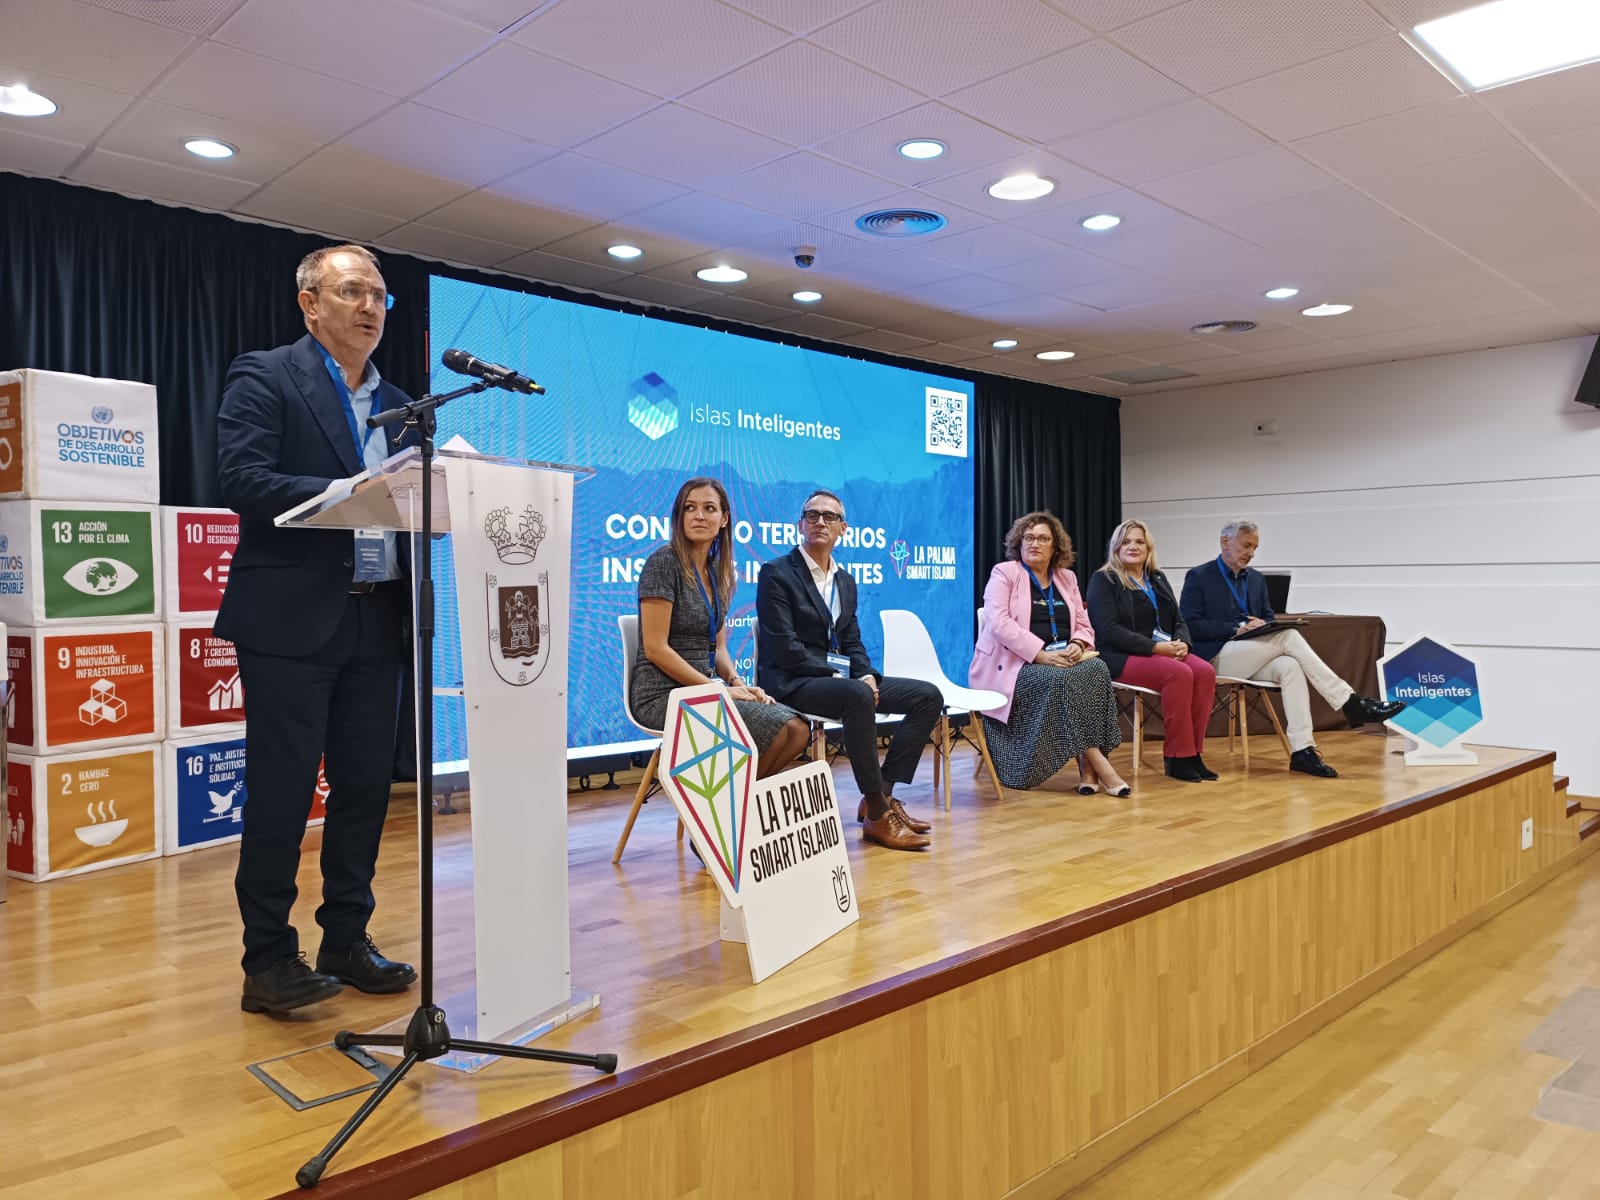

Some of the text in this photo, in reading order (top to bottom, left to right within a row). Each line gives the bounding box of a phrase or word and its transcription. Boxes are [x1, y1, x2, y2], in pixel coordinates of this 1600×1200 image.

[690, 401, 842, 441] Islas Inteligentes
[57, 423, 145, 445] OBJETIVOS
[58, 438, 145, 455] DE DESARROLLO
[58, 449, 145, 468] SOSTENIBLE
[52, 521, 73, 544] 13
[78, 520, 108, 532] ACCIÓN
[184, 523, 204, 544] 10
[78, 533, 130, 544] POR EL CLIMA
[914, 545, 956, 565] LA PALMA
[906, 565, 956, 580] SMART ISLAND
[190, 638, 201, 659] 8
[204, 648, 209, 657] Y
[57, 647, 71, 670] 9
[75, 654, 127, 668] INNOVACIÓN E
[75, 664, 145, 679] INFRAESTRUCTURA
[1417, 671, 1446, 684] Islas
[1394, 685, 1472, 699] Inteligentes
[78, 767, 111, 781] HAMBRE
[186, 755, 204, 777] 16
[209, 763, 214, 773] E
[61, 773, 73, 796] 2
[208, 771, 236, 784] SÓLIDAS
[79, 781, 100, 793] CERO
[755, 772, 834, 837] LA PALMA
[750, 815, 840, 883] SMART ISLAND
